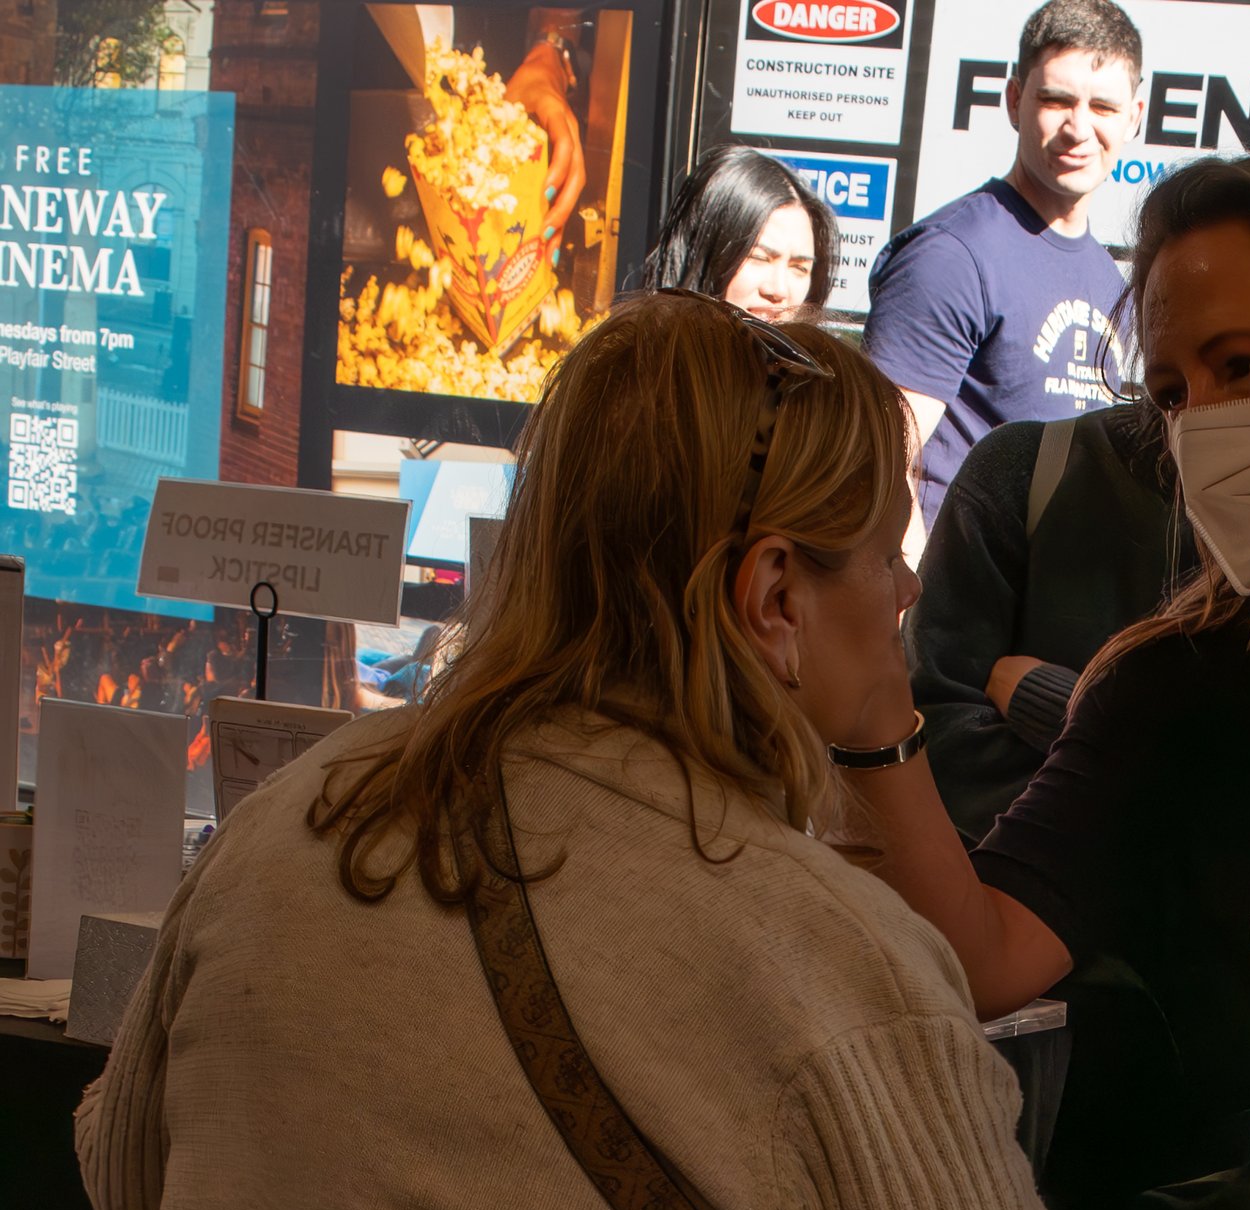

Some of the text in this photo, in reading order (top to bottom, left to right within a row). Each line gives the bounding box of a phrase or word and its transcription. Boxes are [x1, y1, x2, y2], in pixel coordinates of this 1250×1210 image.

[773, 2, 877, 32] DANGER
[746, 58, 895, 80] CONSTRUCTION SITE
[746, 87, 889, 106] UNAUTHORISED PERSONS
[787, 110, 843, 122] KEEP OUT
[16, 144, 92, 176] FREE
[854, 257, 867, 268] IN
[60, 325, 96, 346] from
[99, 327, 134, 352] 7pm
[51, 350, 97, 373] Street
